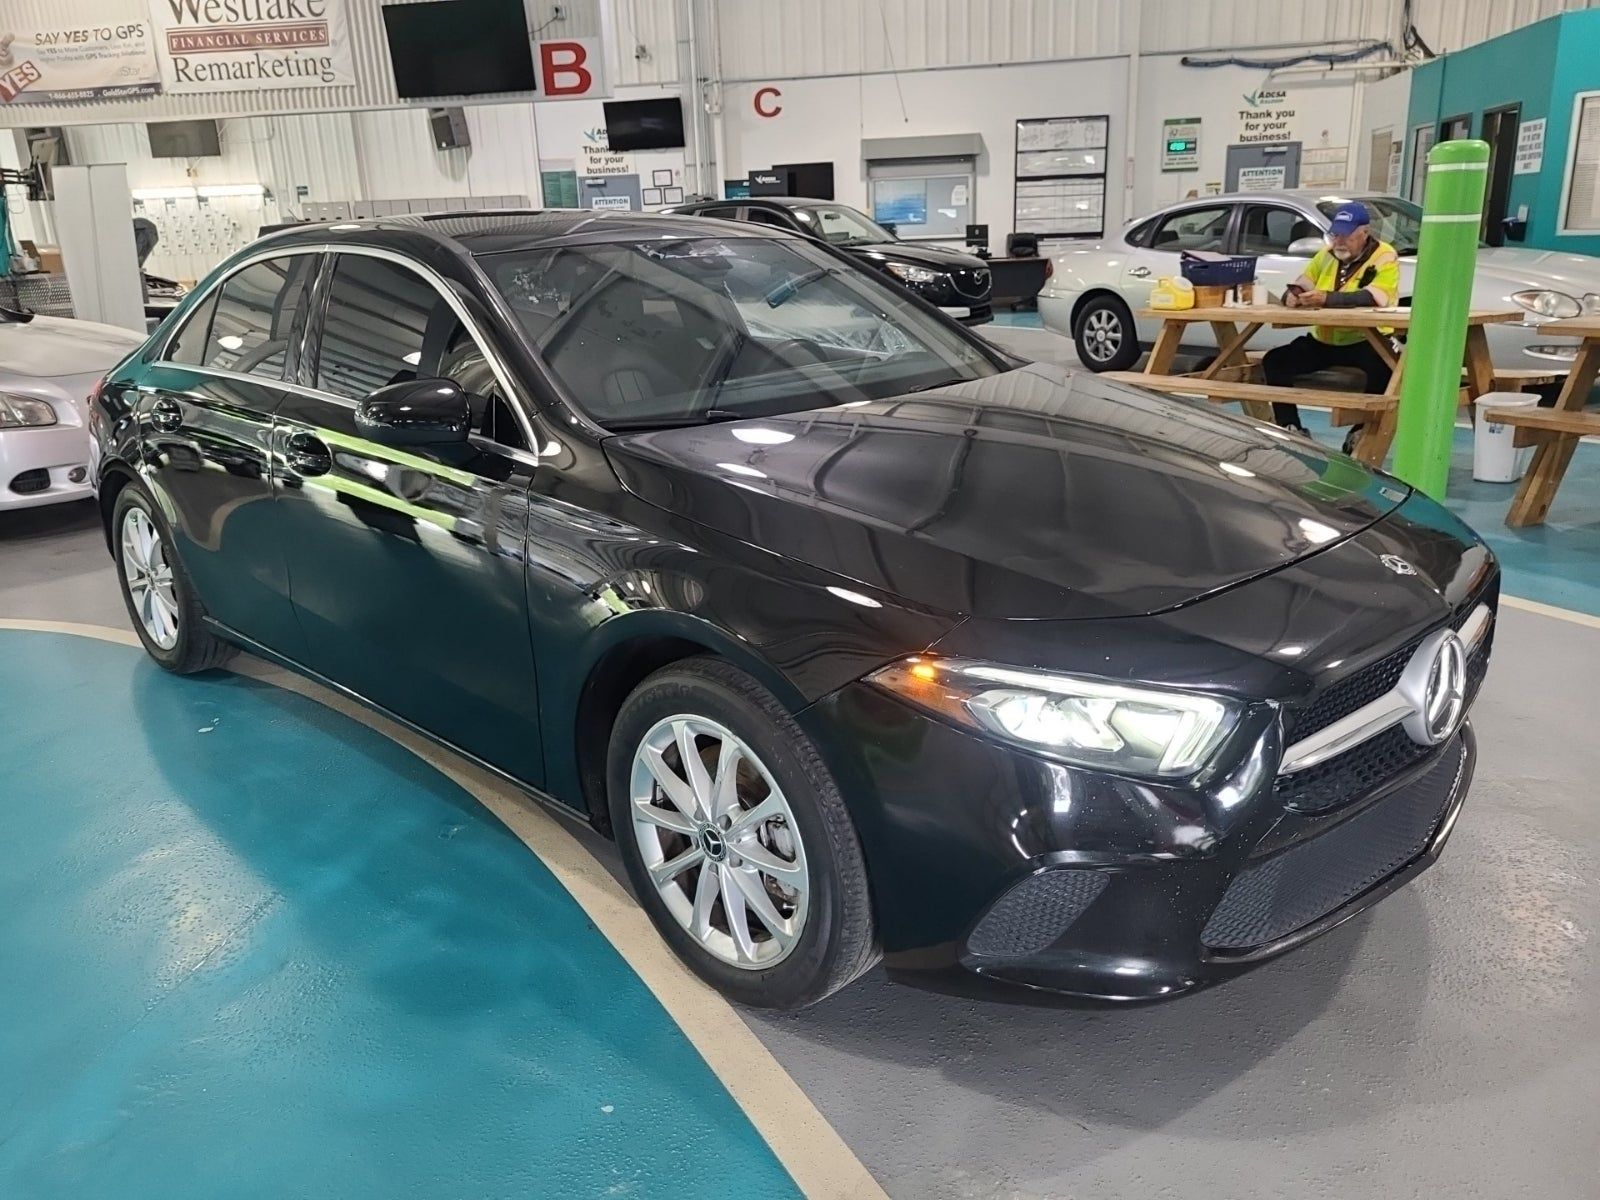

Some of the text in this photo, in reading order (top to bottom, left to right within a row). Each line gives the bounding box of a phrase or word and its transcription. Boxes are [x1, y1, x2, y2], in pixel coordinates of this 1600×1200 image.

[168, 0, 326, 25] Westlake
[35, 24, 144, 46] SAY YES TO GPS
[171, 29, 326, 49] FINANCIAL SERVICES
[171, 50, 336, 83] Remarketing
[540, 42, 592, 96] B
[0, 62, 39, 96] YES
[754, 87, 782, 118] C
[1239, 109, 1295, 122] Thank you
[1245, 121, 1287, 132] for your
[1239, 131, 1291, 142] business!
[586, 165, 629, 174] business!
[590, 156, 624, 167] for your
[1241, 168, 1283, 177] ATTENTION
[594, 198, 629, 206] ATTENTION
